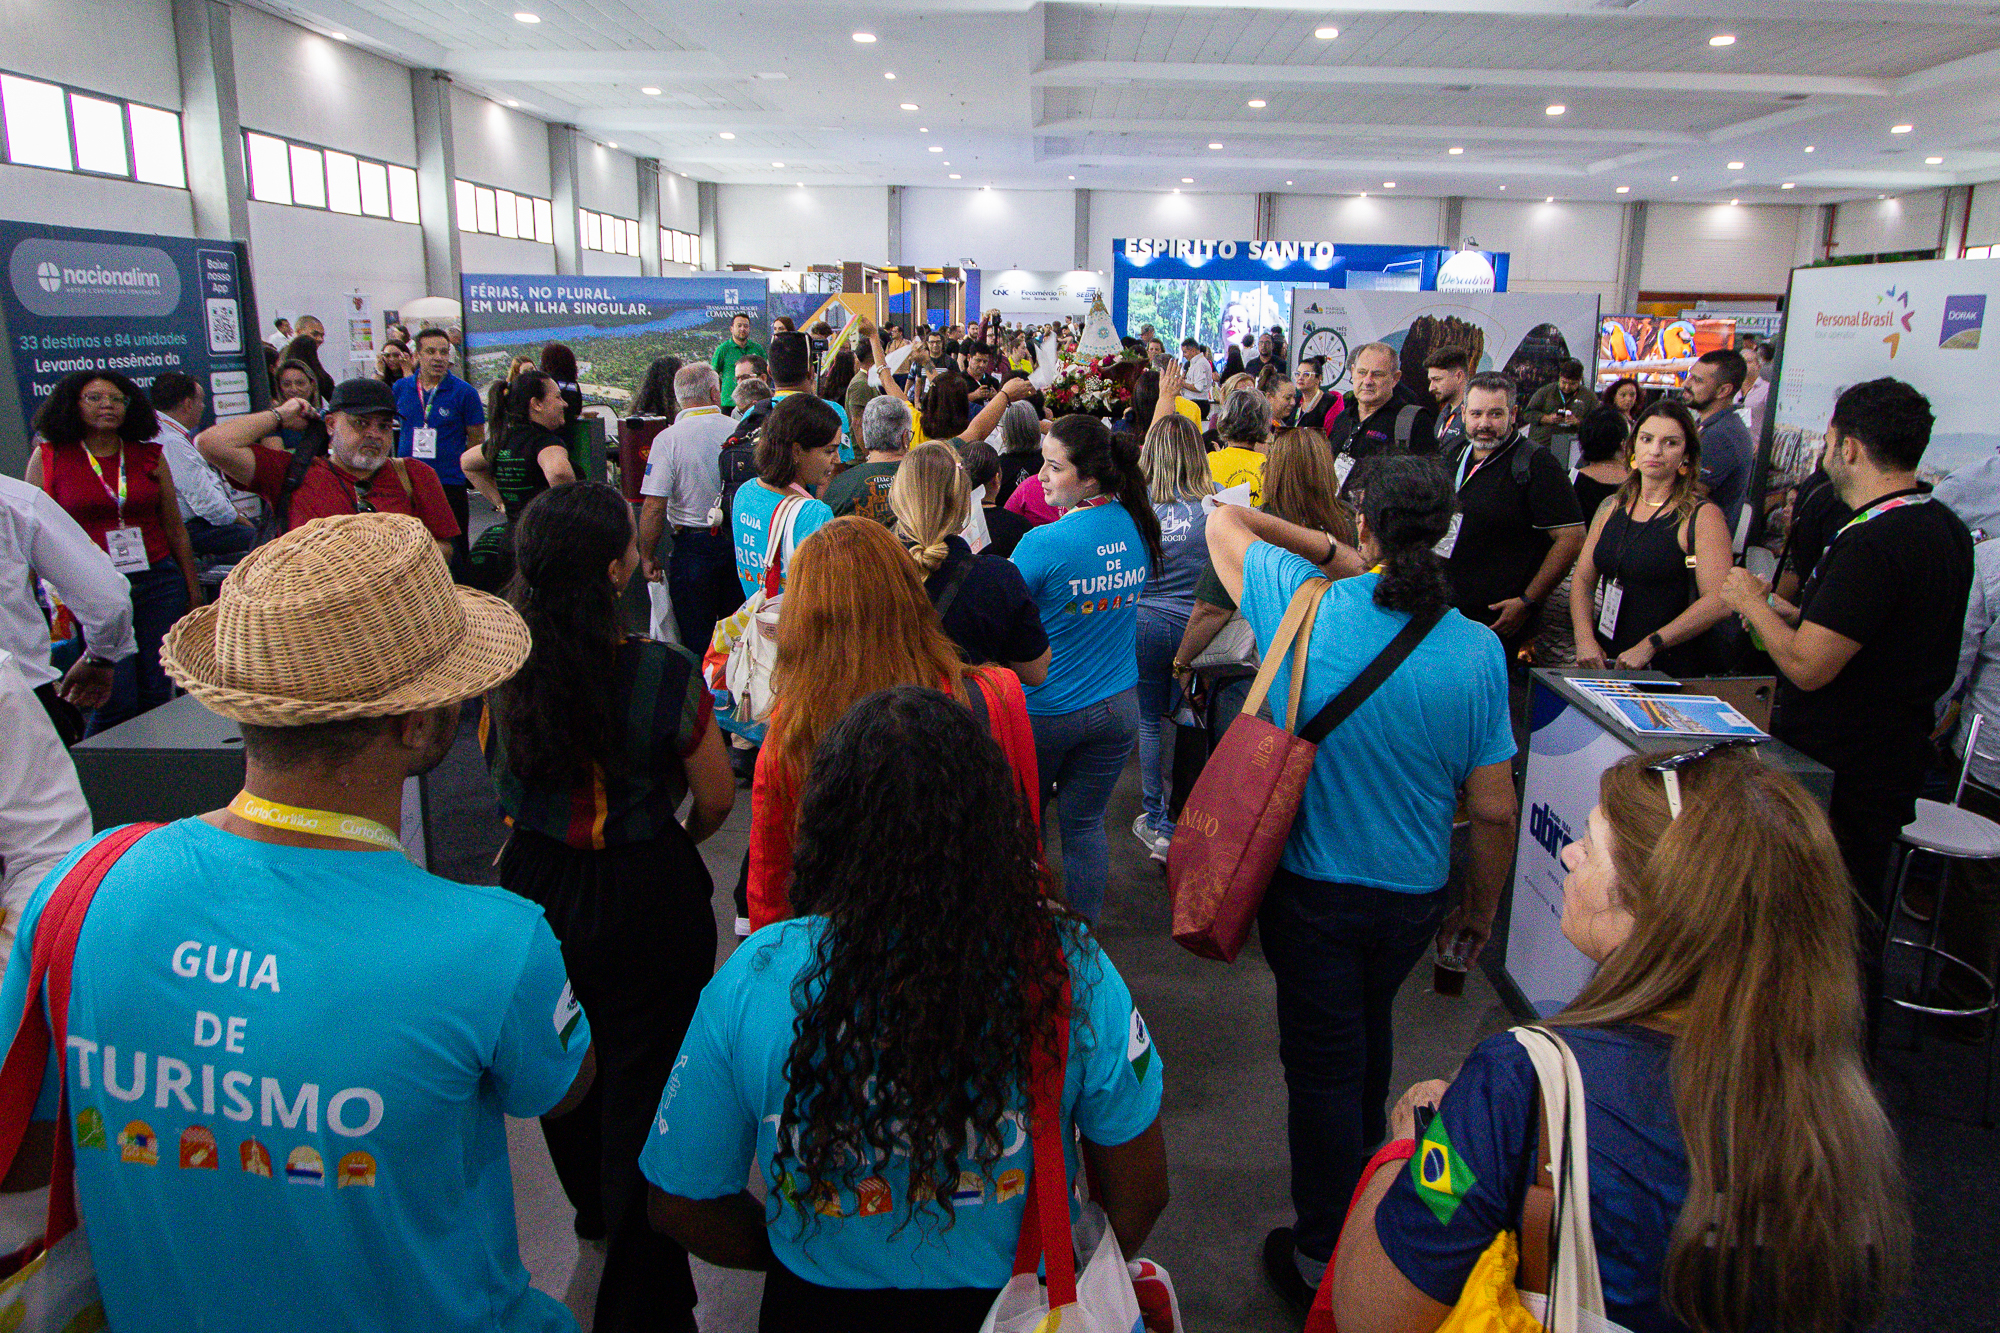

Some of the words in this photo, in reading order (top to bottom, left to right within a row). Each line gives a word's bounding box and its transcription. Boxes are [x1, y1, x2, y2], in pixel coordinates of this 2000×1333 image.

[1248, 241, 1335, 261] SANTO
[206, 258, 229, 270] Baixe
[62, 263, 161, 287] nacionalinn
[207, 272, 231, 281] nosso
[1439, 272, 1492, 285] Descubra
[213, 282, 229, 294] App
[470, 282, 525, 300] FÉRIAS,
[529, 287, 552, 299] NO
[557, 287, 616, 301] PLURAL.
[471, 301, 493, 314] EM
[497, 301, 530, 314] UMA
[534, 301, 569, 314] ILHA
[573, 302, 652, 316] SINGULAR.
[1948, 311, 1978, 321] DORAK
[1816, 311, 1860, 327] Personal
[1861, 311, 1894, 326] Brasil
[20, 335, 38, 350] 33
[42, 334, 101, 349] destinos
[103, 336, 112, 347] e
[115, 333, 131, 346] 84
[134, 332, 188, 346] unidades
[35, 356, 94, 372] Levando
[97, 358, 106, 370] a
[108, 353, 161, 369] essência
[164, 352, 181, 366] da
[740, 512, 762, 531] GUIA
[743, 532, 755, 547] DE
[1096, 541, 1128, 557] GUIA
[1106, 558, 1122, 572] DE
[1068, 566, 1146, 596] TURISMO
[171, 940, 281, 993] GUIA
[194, 1011, 247, 1054] DE
[67, 1035, 385, 1138] TURISMO
